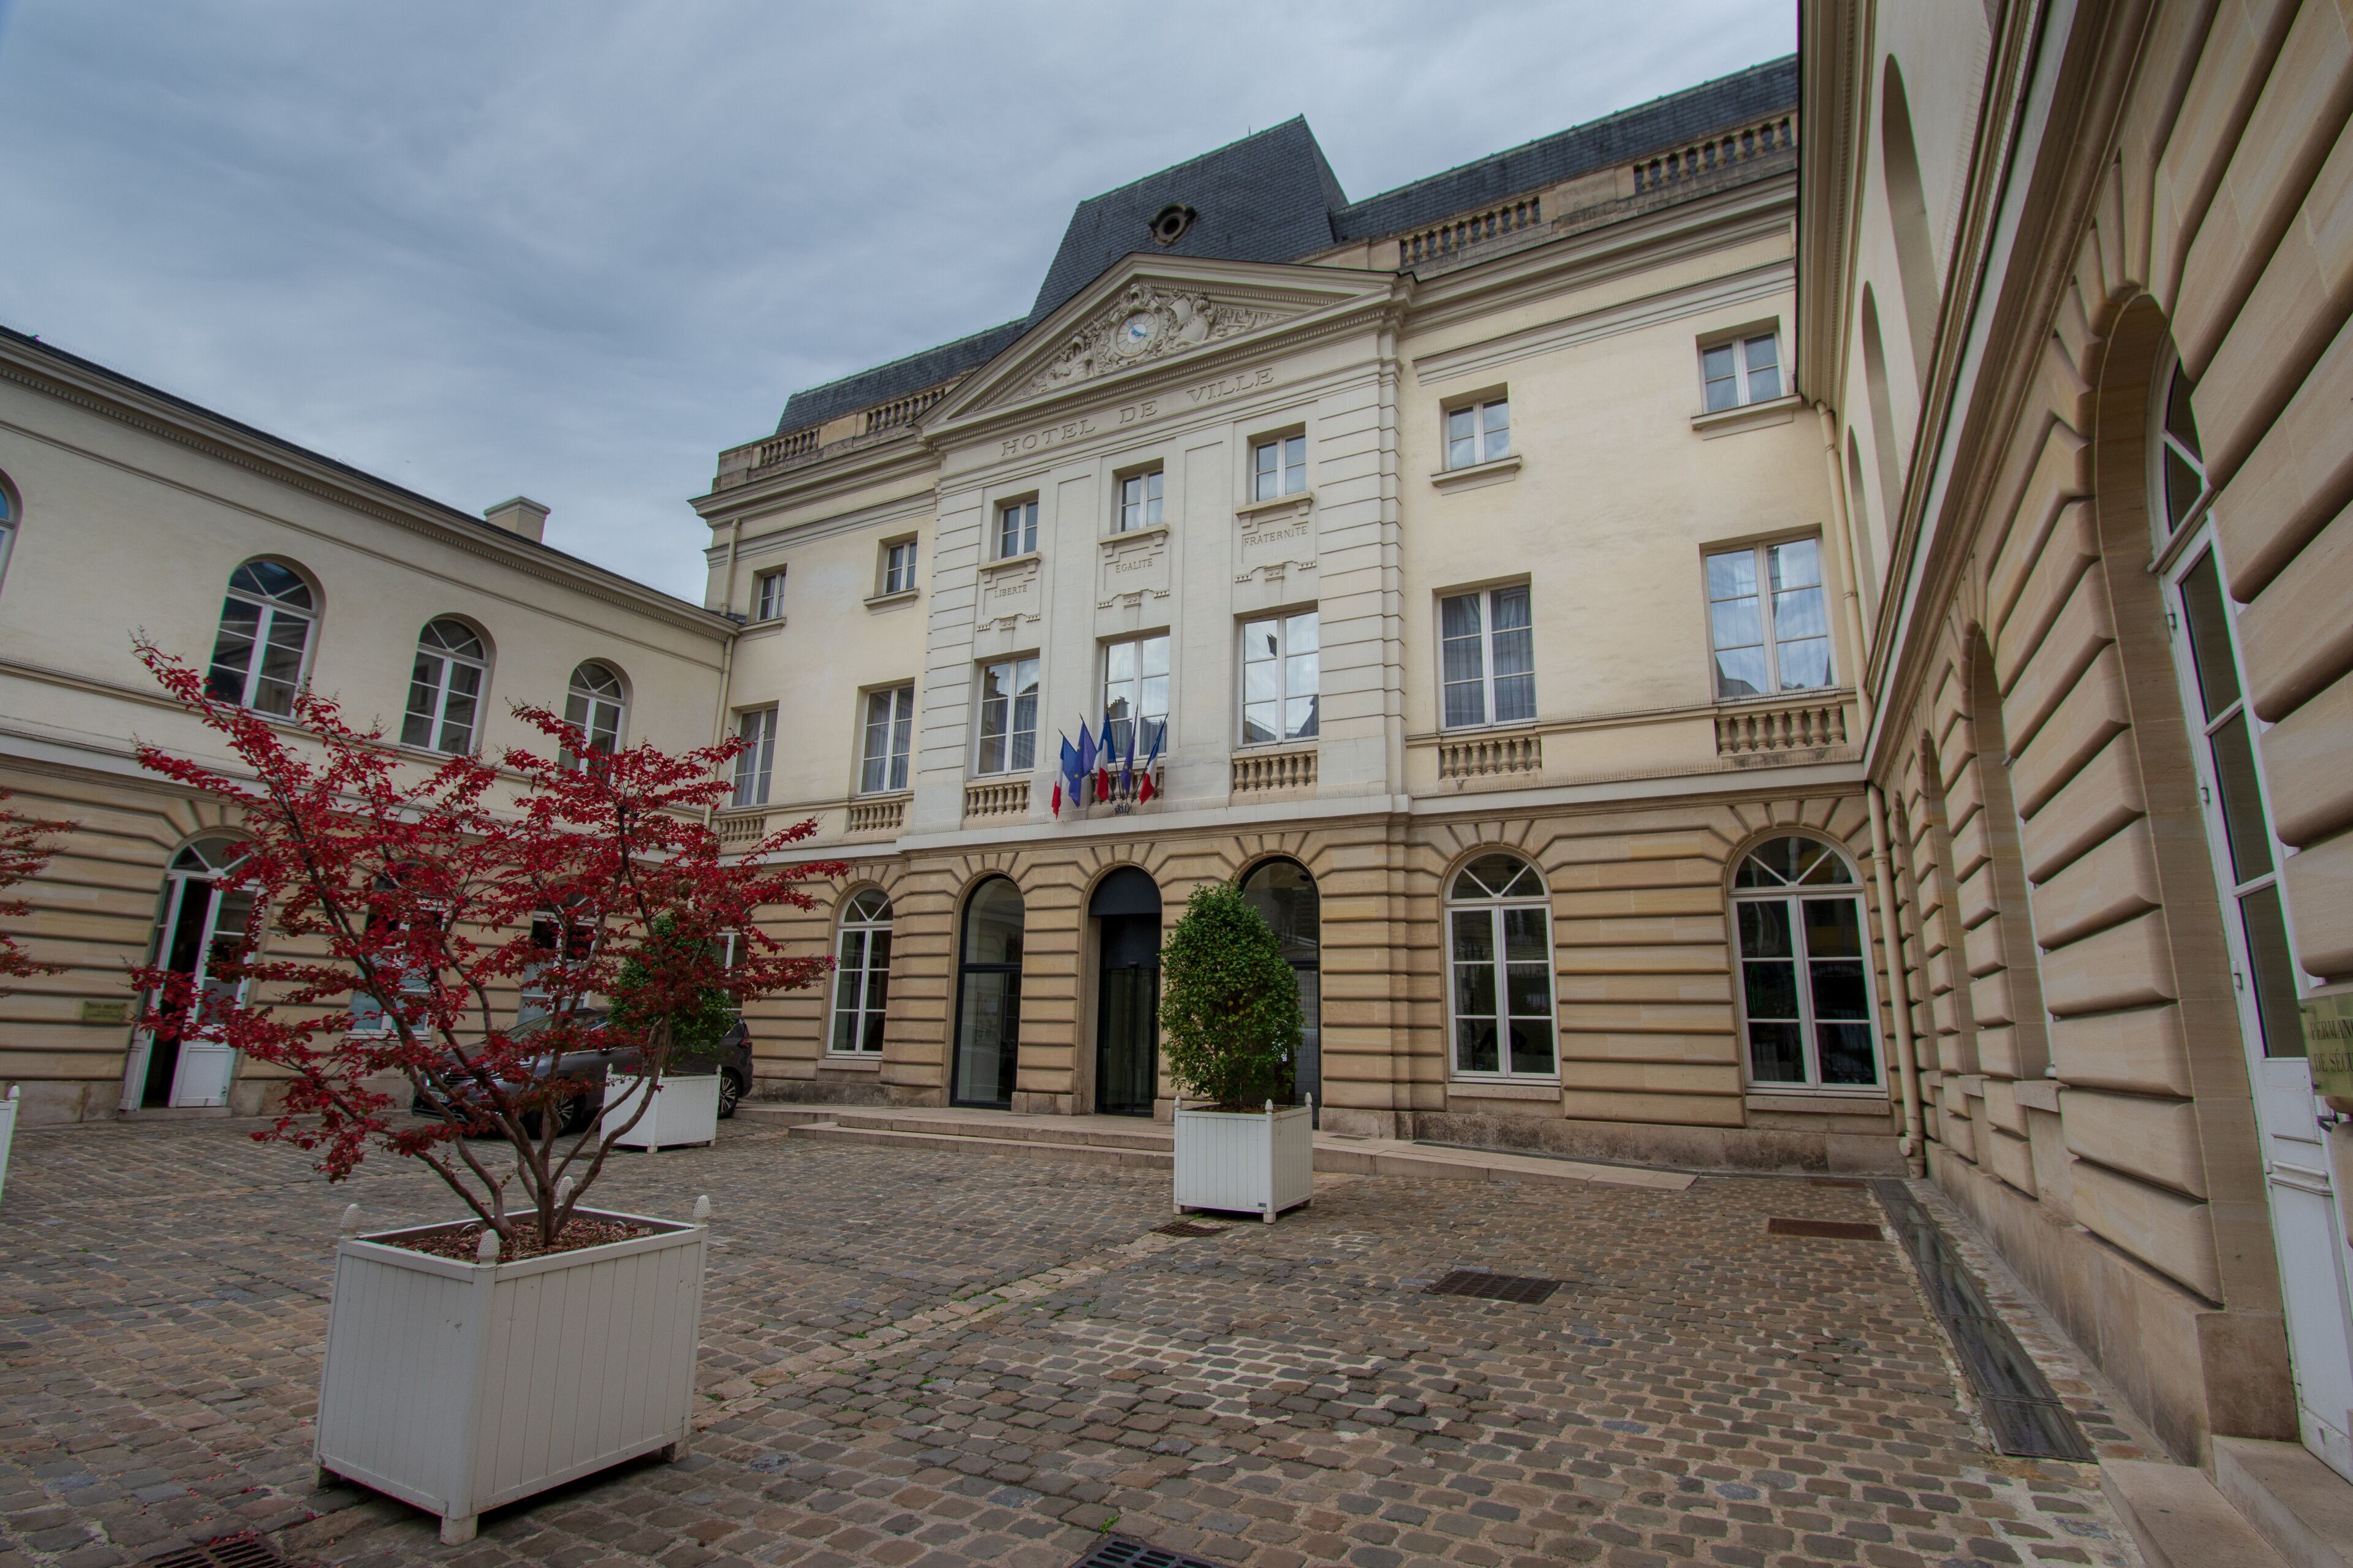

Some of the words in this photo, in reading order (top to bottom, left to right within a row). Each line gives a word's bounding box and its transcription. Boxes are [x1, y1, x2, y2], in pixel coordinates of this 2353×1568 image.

[1001, 419, 1096, 456] HOTEL
[1120, 400, 1158, 424] DE
[1186, 368, 1274, 403] VILLE
[1244, 525, 1308, 547] FRATERNITE
[1116, 558, 1153, 574] EGALITE
[995, 584, 1028, 599] LIBERTE
[2309, 1019, 2353, 1040] PERMAN
[2313, 1053, 2328, 1072] DE
